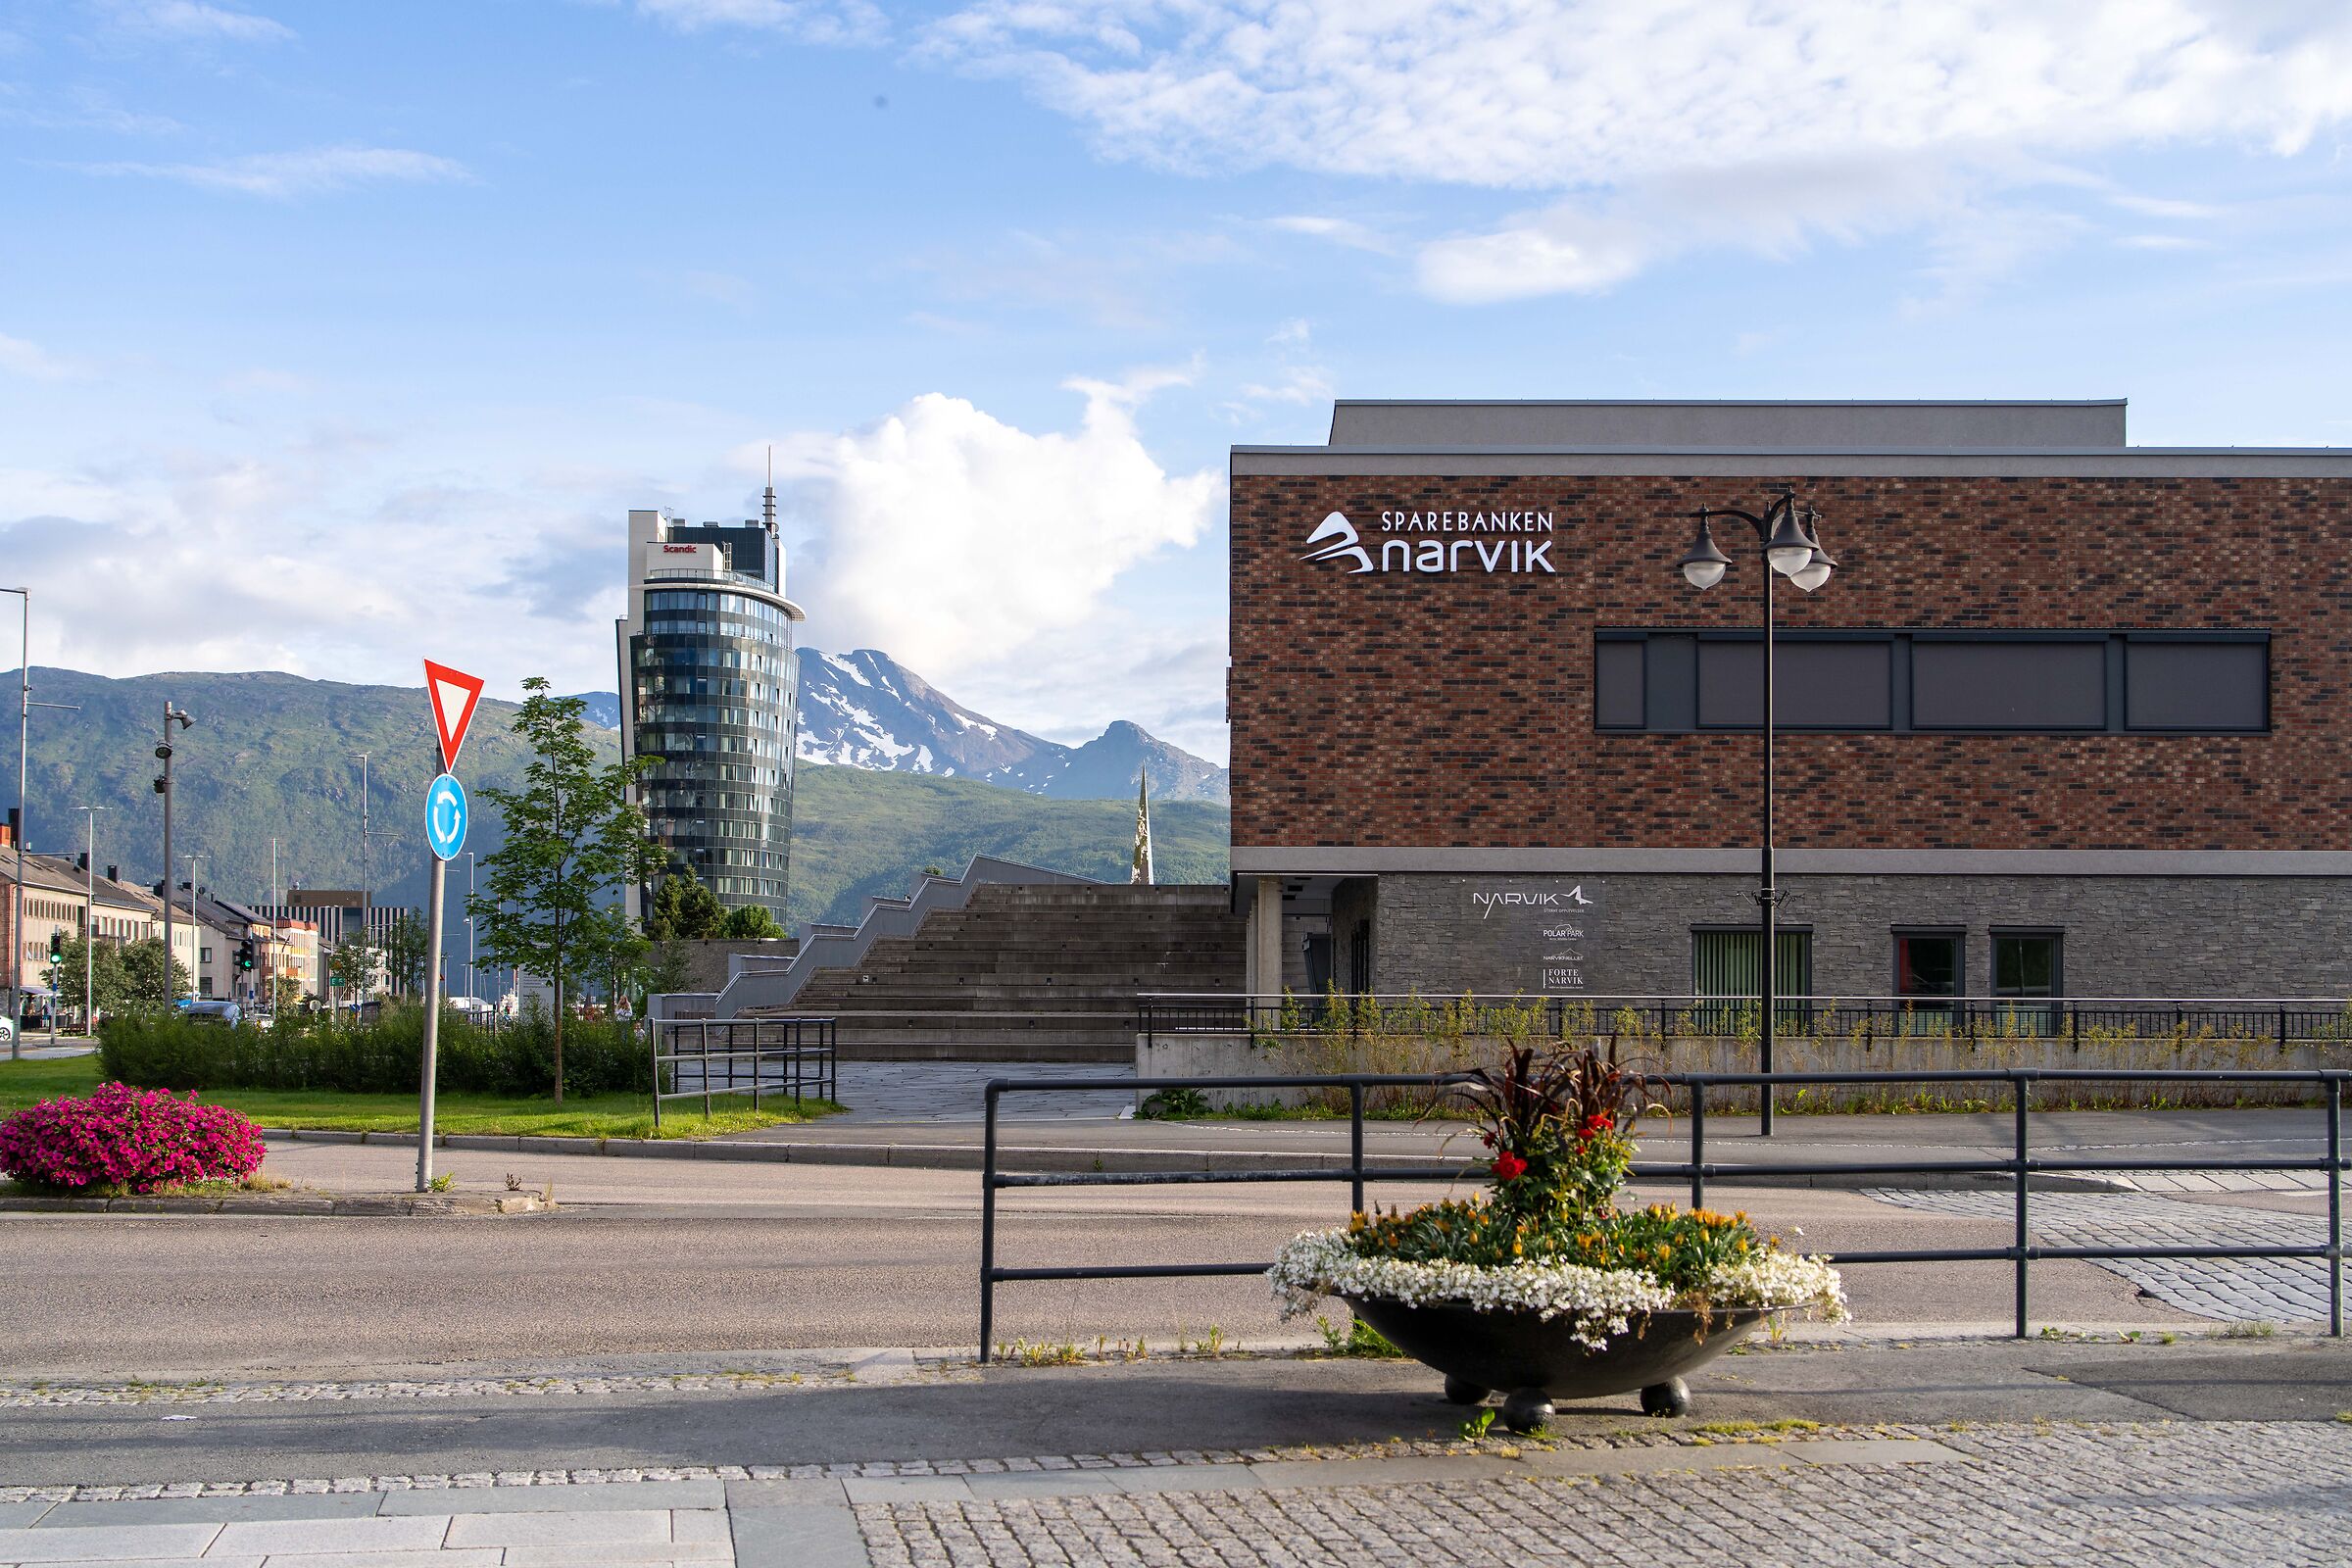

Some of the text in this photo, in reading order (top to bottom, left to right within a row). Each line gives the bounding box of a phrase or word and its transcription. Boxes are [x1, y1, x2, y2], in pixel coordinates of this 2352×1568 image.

[1381, 511, 1553, 532] SPAREBANKEN
[663, 545, 697, 554] Scandic
[1381, 539, 1556, 573] narvik
[1473, 893, 1559, 919] NARVIK
